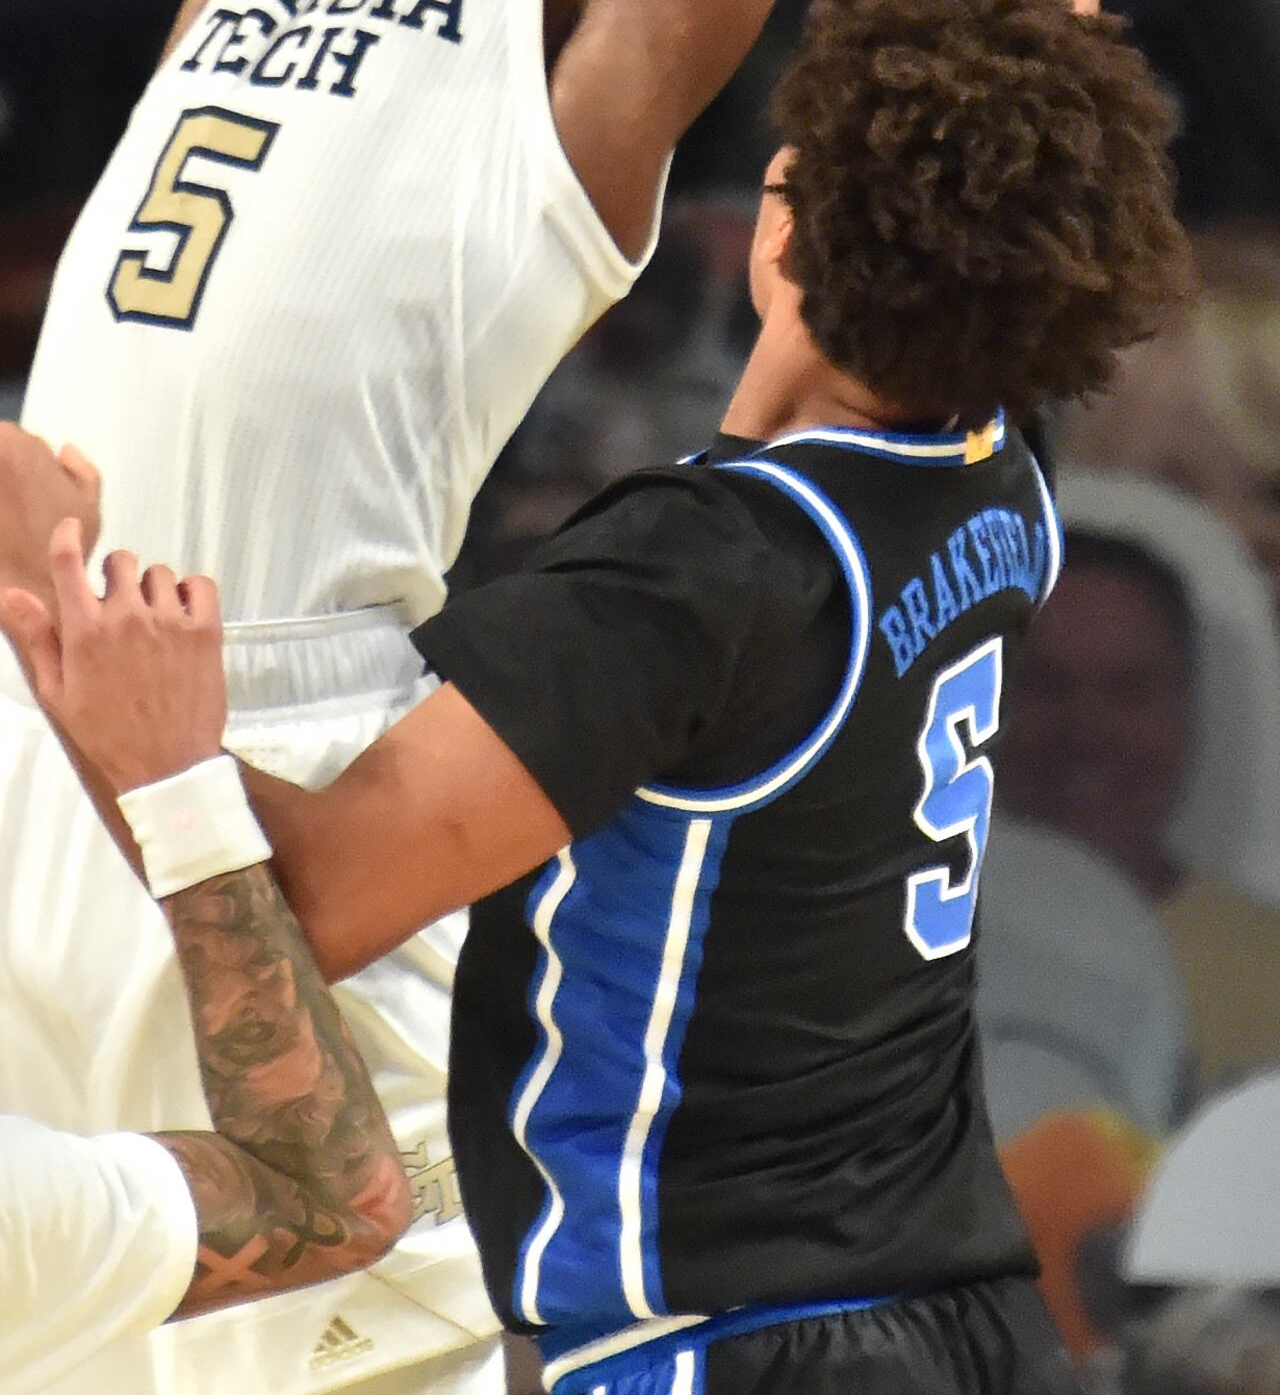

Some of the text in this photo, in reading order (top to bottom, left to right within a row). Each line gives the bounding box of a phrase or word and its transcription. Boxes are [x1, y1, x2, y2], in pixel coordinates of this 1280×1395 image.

[181, 8, 380, 97] TECH
[105, 105, 282, 332] 5
[904, 634, 1003, 961] 5
